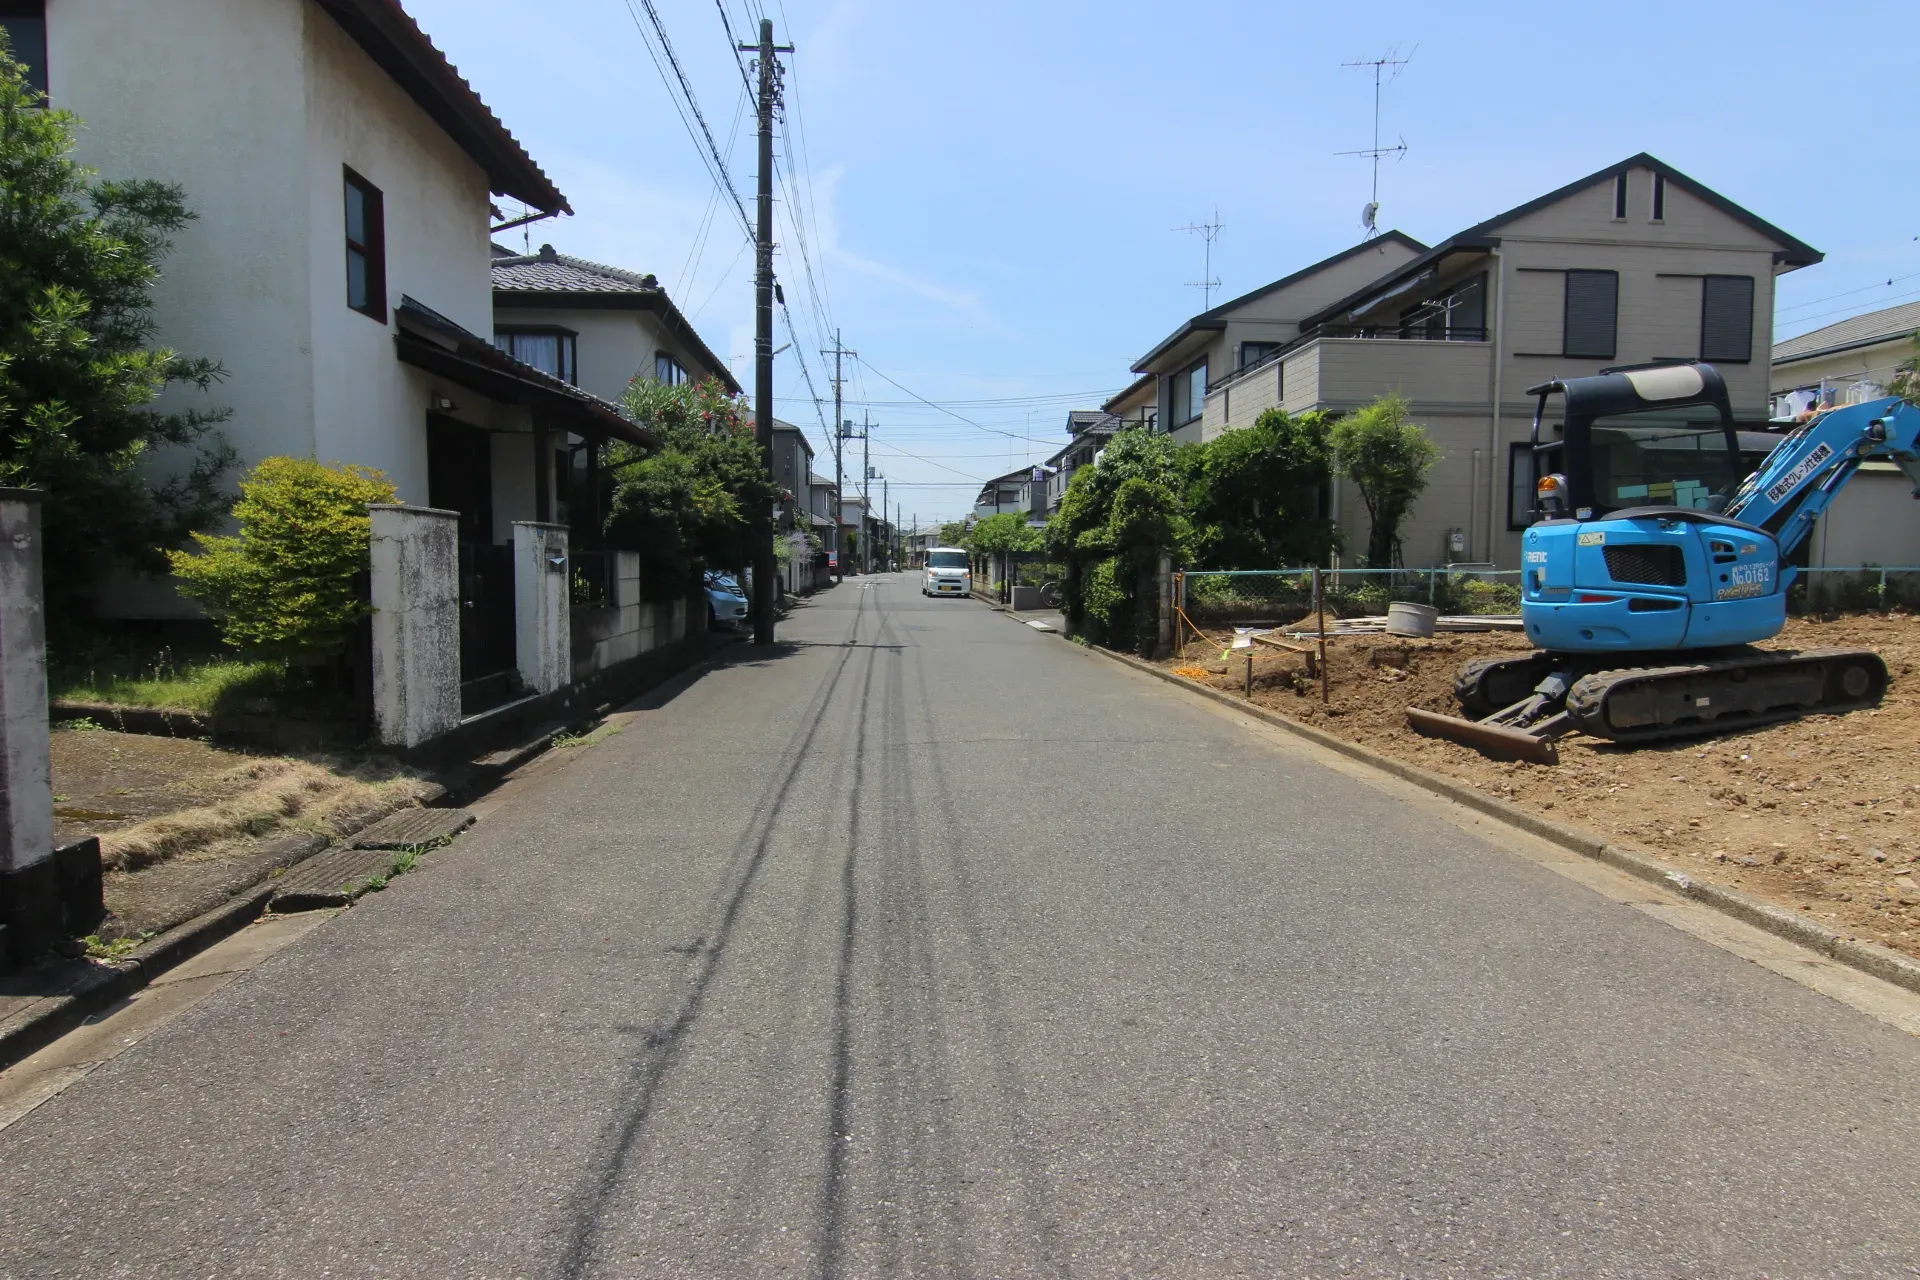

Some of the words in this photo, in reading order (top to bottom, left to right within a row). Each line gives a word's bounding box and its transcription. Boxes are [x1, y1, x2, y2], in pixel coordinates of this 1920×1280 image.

[1767, 445, 1831, 502] 移動式クレーン仕様機
[1732, 568, 1770, 586] No.0162
